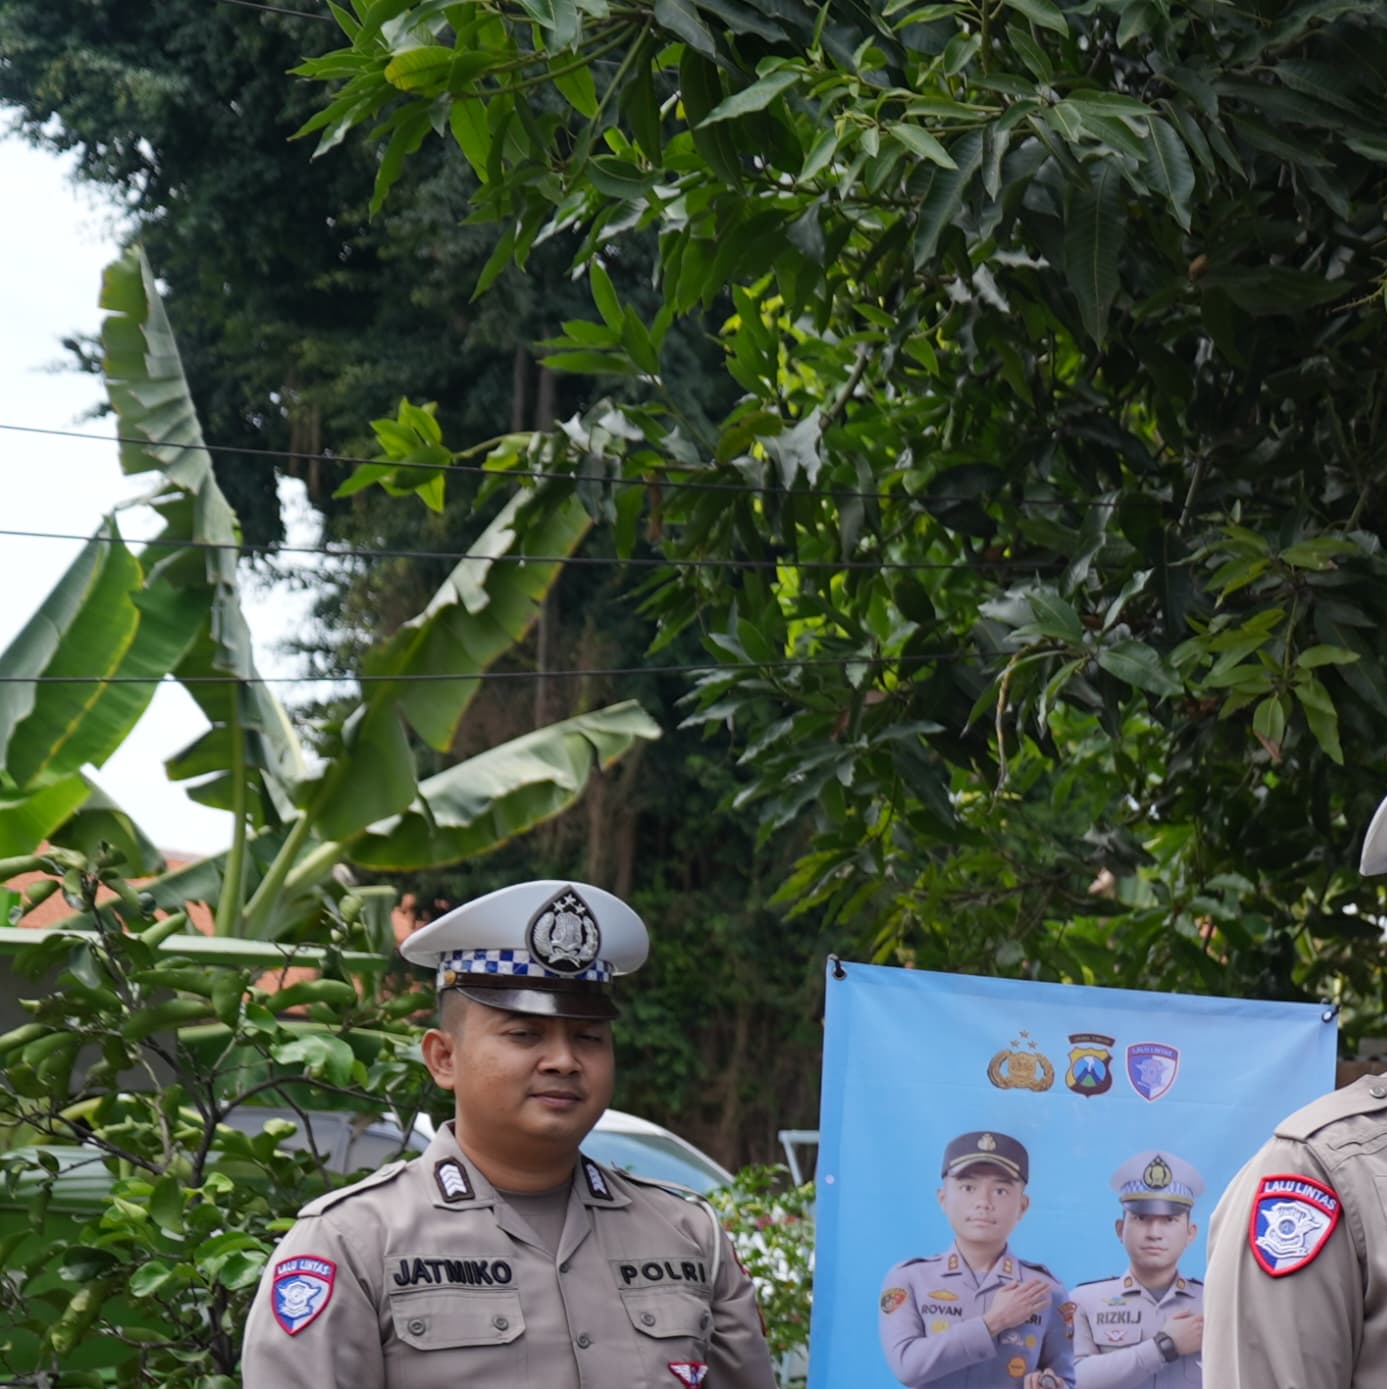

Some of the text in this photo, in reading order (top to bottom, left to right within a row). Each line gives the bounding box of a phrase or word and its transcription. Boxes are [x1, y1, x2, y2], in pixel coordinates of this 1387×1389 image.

[1264, 1181, 1337, 1210] LALU LINTAS
[393, 1257, 513, 1286] JATMIKO
[620, 1262, 706, 1285] POLRI
[921, 1303, 963, 1318] ROVAN
